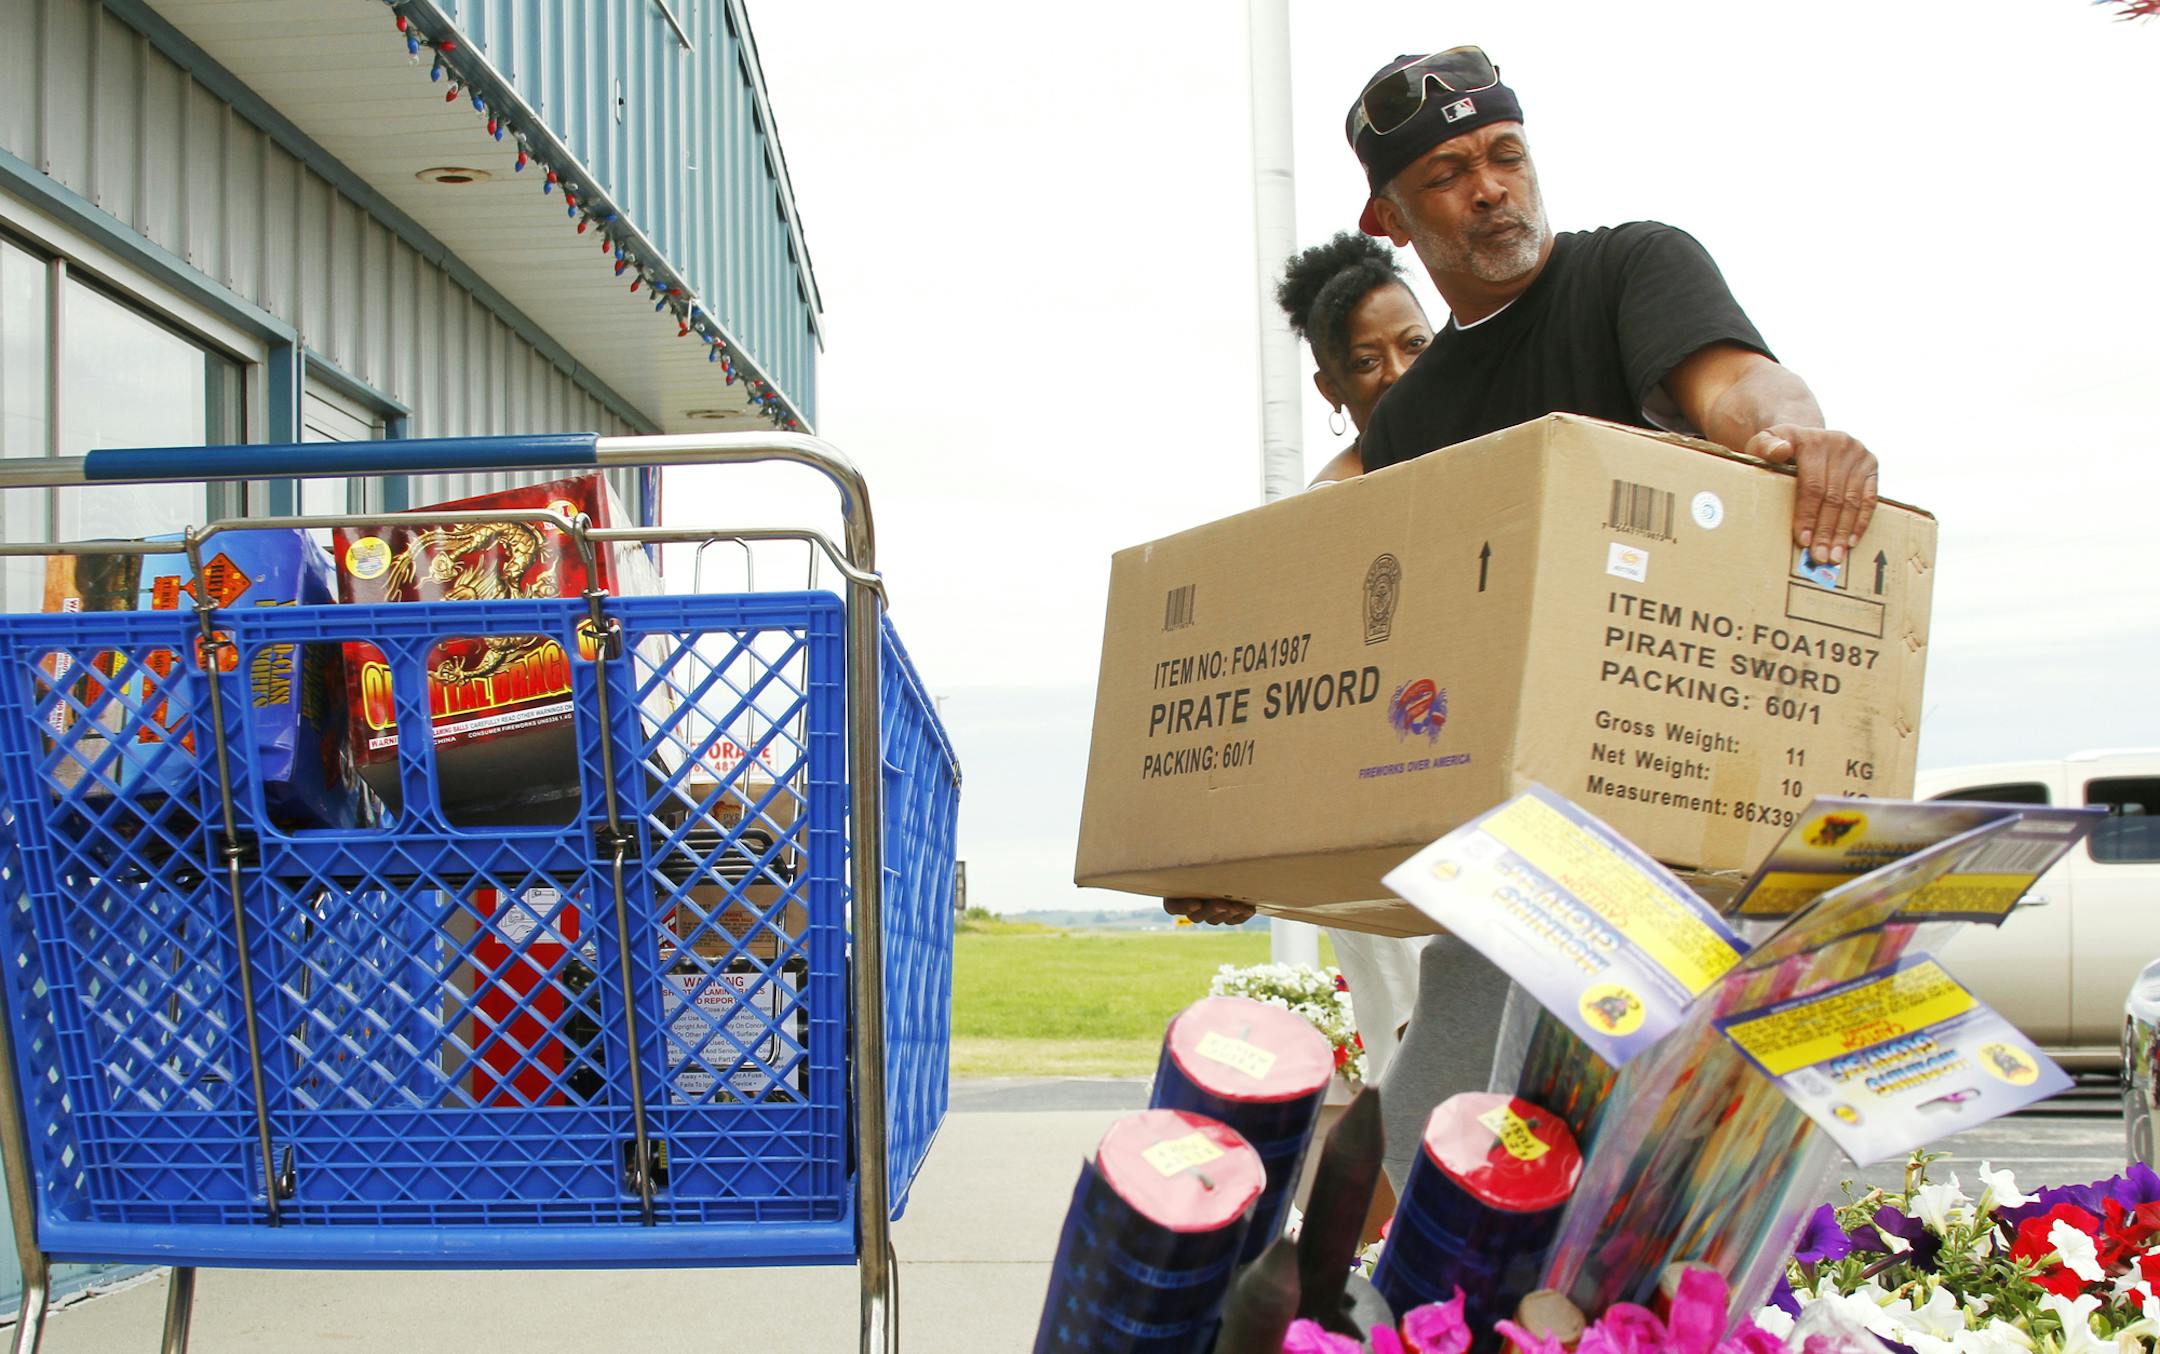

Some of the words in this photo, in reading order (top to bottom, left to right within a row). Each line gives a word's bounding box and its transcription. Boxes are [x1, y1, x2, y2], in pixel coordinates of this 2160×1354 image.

[1608, 591, 1682, 627] ITEM
[1691, 610, 1743, 640] NO:
[1752, 624, 1880, 670] FOA1987
[1153, 656, 1194, 689] ITEM
[1197, 650, 1228, 682] NO:
[1232, 633, 1312, 675] FOA1987
[1606, 626, 1716, 669] PIRATE
[1730, 654, 1841, 695] SWORD
[470, 718, 502, 729] CAREFULLY
[502, 714, 517, 725] READ
[517, 711, 535, 720] OTHER
[535, 706, 564, 717] WARNINGS
[1149, 688, 1251, 737] PIRATE
[1264, 665, 1380, 719] SWORD
[1601, 660, 1750, 710] PACKING:
[1765, 696, 1821, 725] 60/1
[468, 727, 502, 739] CONSUMER
[502, 719, 537, 732] FIREWORKS
[1595, 710, 1656, 737] Gross
[1666, 722, 1740, 754] Weight:
[1786, 748, 1805, 767] 11
[1845, 759, 1874, 780] KG
[1142, 745, 1219, 779] PACKING:
[1222, 739, 1255, 767] 60/1
[1358, 762, 1404, 779] FIREWORKS
[1407, 758, 1430, 773] OVER
[1433, 752, 1472, 769] AMERICA
[1591, 742, 1625, 766] Net
[1635, 749, 1710, 780] Weight:
[1781, 778, 1803, 798] 10
[1586, 775, 1728, 816] Measurement:
[1733, 800, 1800, 828] 86X39
